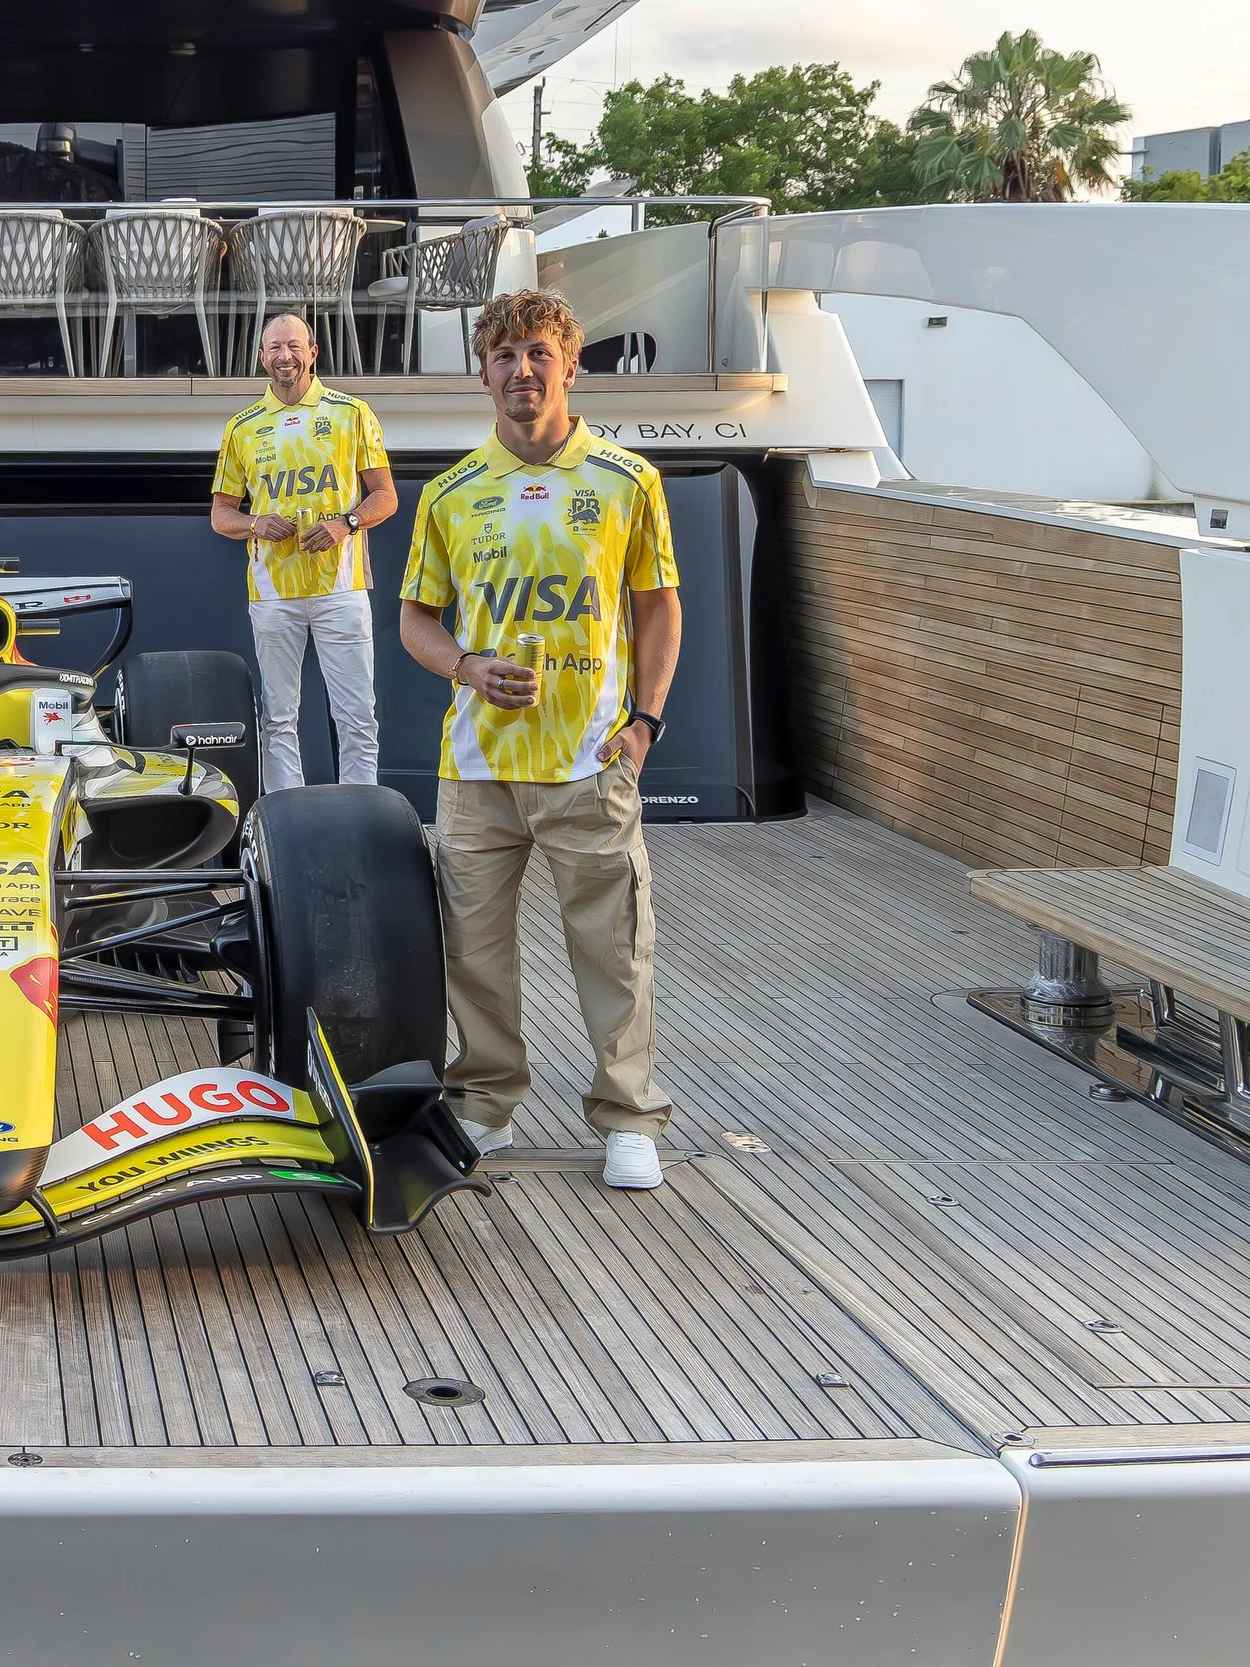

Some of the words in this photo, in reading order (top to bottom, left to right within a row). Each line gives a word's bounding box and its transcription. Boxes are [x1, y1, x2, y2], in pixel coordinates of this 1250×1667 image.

[328, 391, 354, 401] HUGO
[235, 405, 260, 420] HUGO
[638, 423, 703, 440] BAY,
[715, 423, 747, 438] CI
[255, 454, 276, 464] Mobil
[599, 449, 644, 474] HUGO
[437, 459, 478, 488] HUGO
[260, 464, 339, 500] VISA
[574, 489, 596, 497] VISA
[471, 507, 506, 518] RACING
[471, 532, 506, 545] TUDOR
[473, 546, 507, 563] Mobil
[475, 574, 602, 624] VISA
[562, 653, 602, 674] App
[38, 701, 69, 710] Mobil
[197, 735, 238, 745] hahnair
[6, 882, 40, 890] App
[81, 1080, 290, 1151] HUGO
[76, 1166, 146, 1192] YOU
[145, 1136, 269, 1165] WIIINGS
[186, 1174, 263, 1188] App
